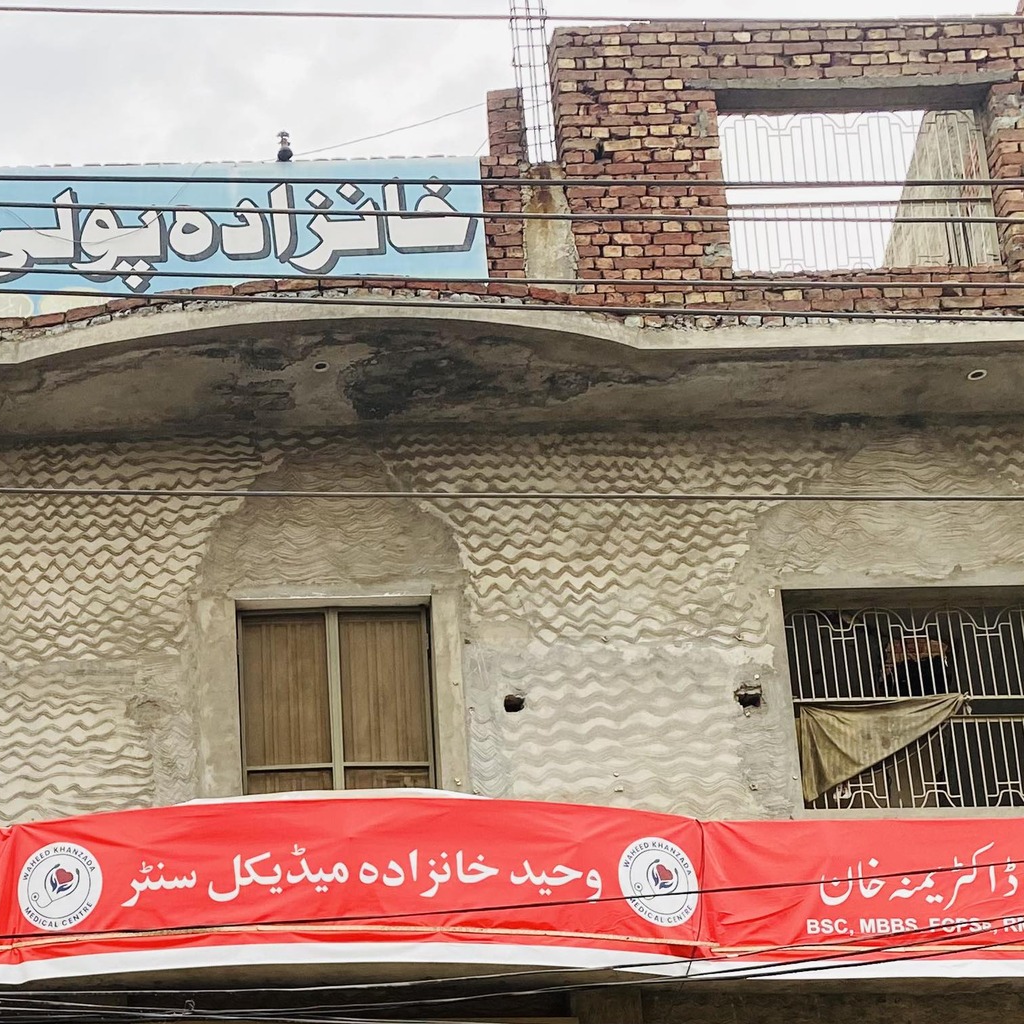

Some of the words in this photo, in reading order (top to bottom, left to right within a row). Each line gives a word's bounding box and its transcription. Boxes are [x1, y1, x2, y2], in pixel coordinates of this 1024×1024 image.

[169, 176, 478, 275] خانزادہ
[22, 849, 51, 881] WAHEED
[53, 846, 96, 872] KHANZADA
[208, 843, 349, 902] میڈیکل
[359, 848, 500, 899] خانزادہ
[623, 842, 649, 868] WAHEED
[652, 841, 692, 876] KHANZADA
[943, 841, 1019, 911] ڈاکٹر
[121, 861, 196, 906] سنٹر
[510, 860, 602, 903] وحید
[819, 857, 887, 906] خان
[24, 907, 58, 928] MEDICAL
[61, 902, 93, 927] CENTRE
[630, 896, 664, 923] MEDICAL
[806, 918, 854, 936] BSC,
